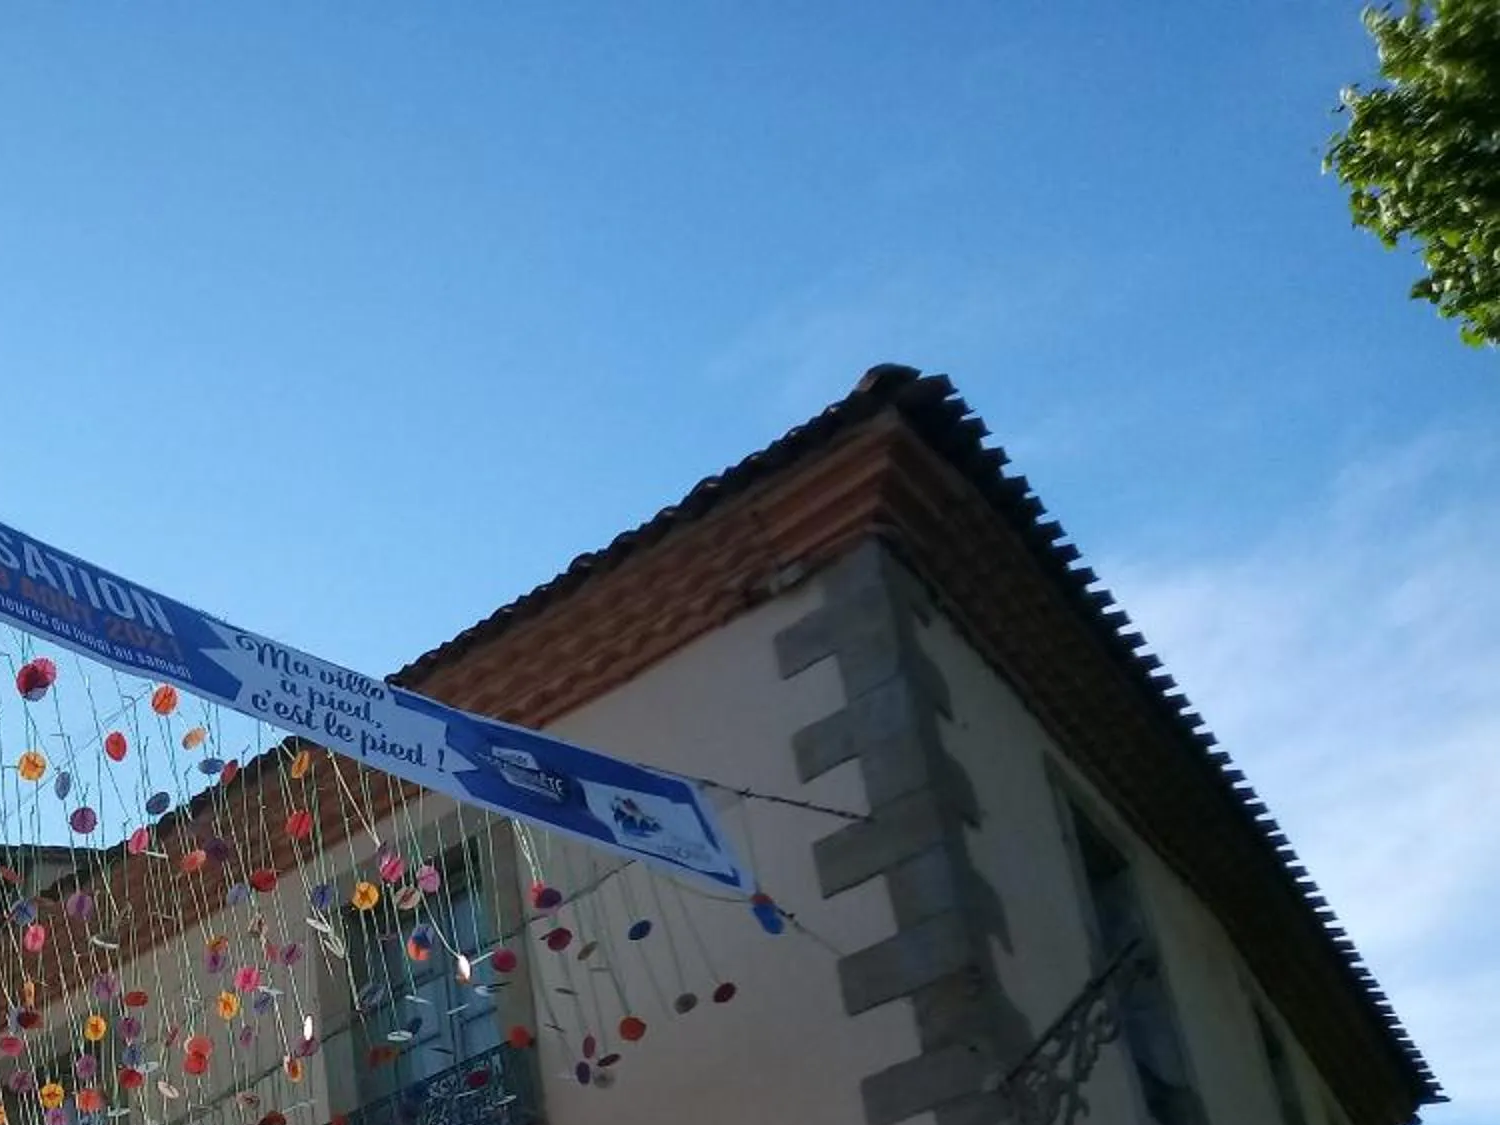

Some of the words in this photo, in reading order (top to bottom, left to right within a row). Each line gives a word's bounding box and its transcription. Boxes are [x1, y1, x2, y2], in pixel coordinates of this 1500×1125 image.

[236, 634, 316, 677] Ma
[320, 667, 385, 702] ville
[251, 688, 320, 731] c'est
[324, 711, 355, 743] le
[360, 728, 428, 768] pied
